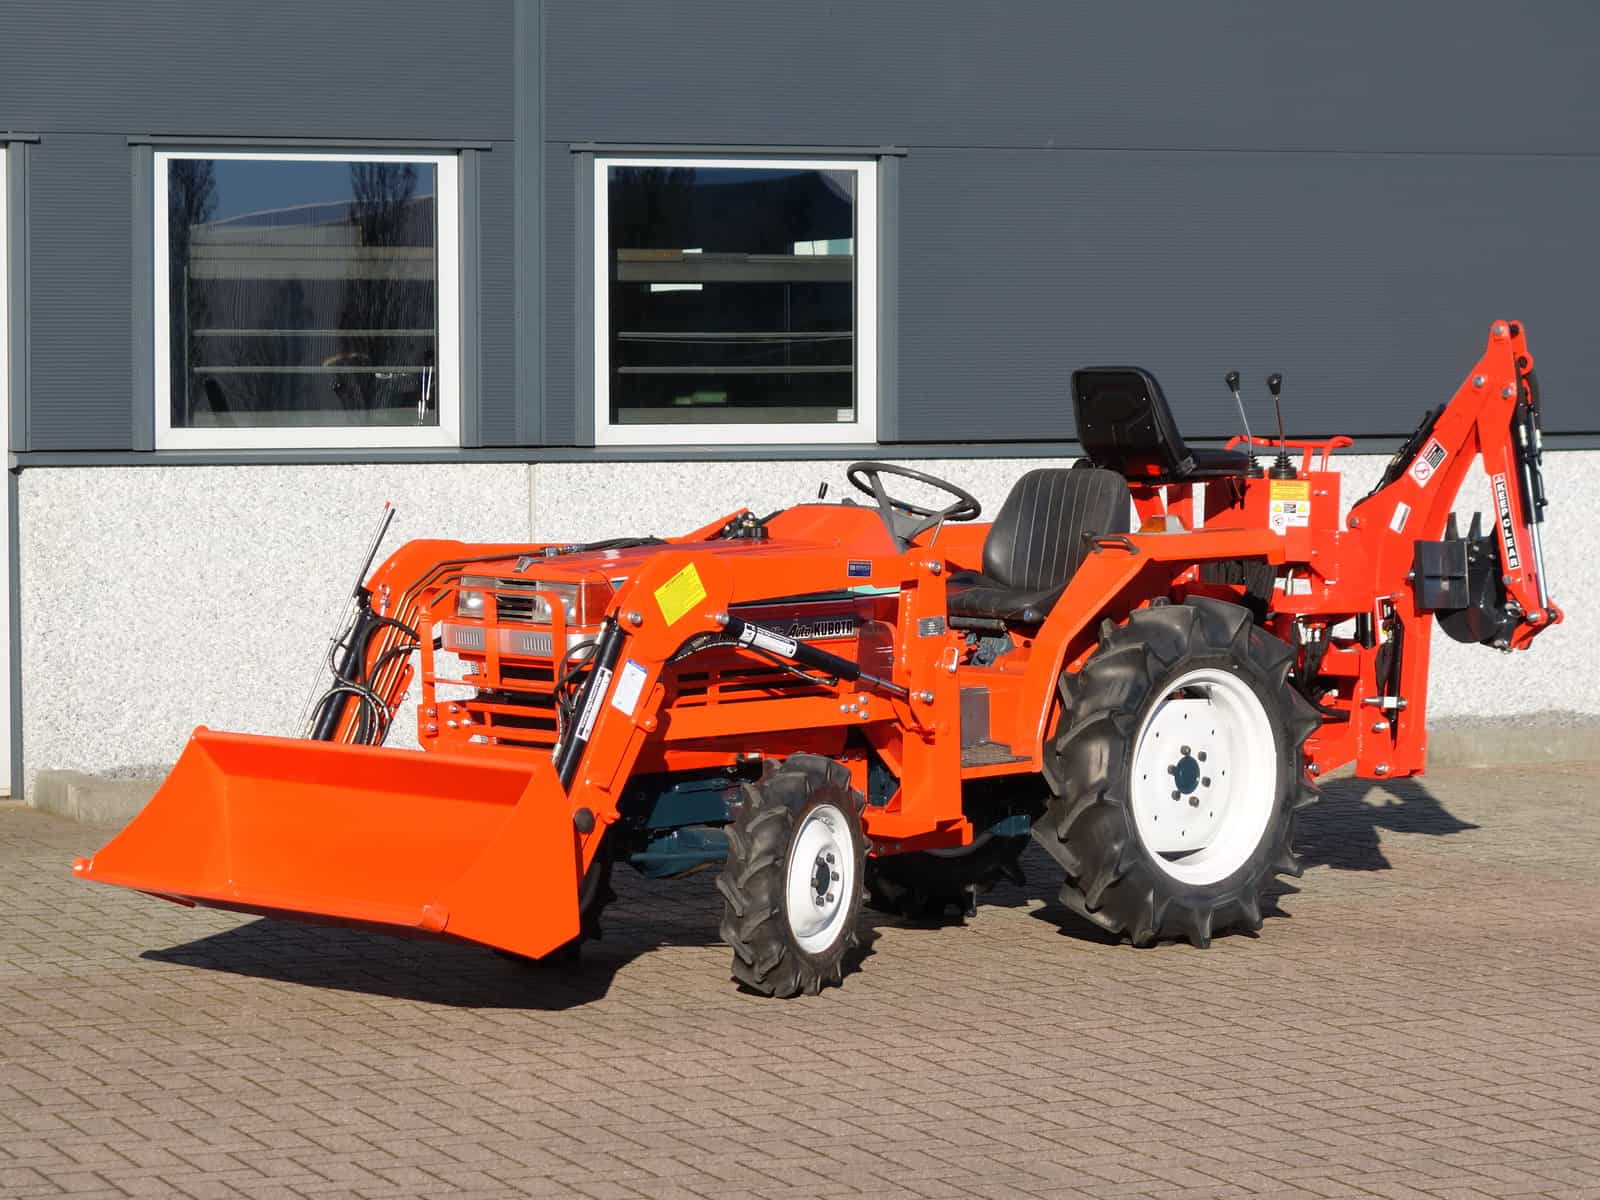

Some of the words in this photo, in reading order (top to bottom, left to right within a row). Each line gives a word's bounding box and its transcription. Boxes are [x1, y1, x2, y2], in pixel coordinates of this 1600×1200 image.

[1496, 482, 1509, 516] KEEP
[1503, 518, 1519, 568] CLEAR
[813, 620, 853, 637] KUBOTA
